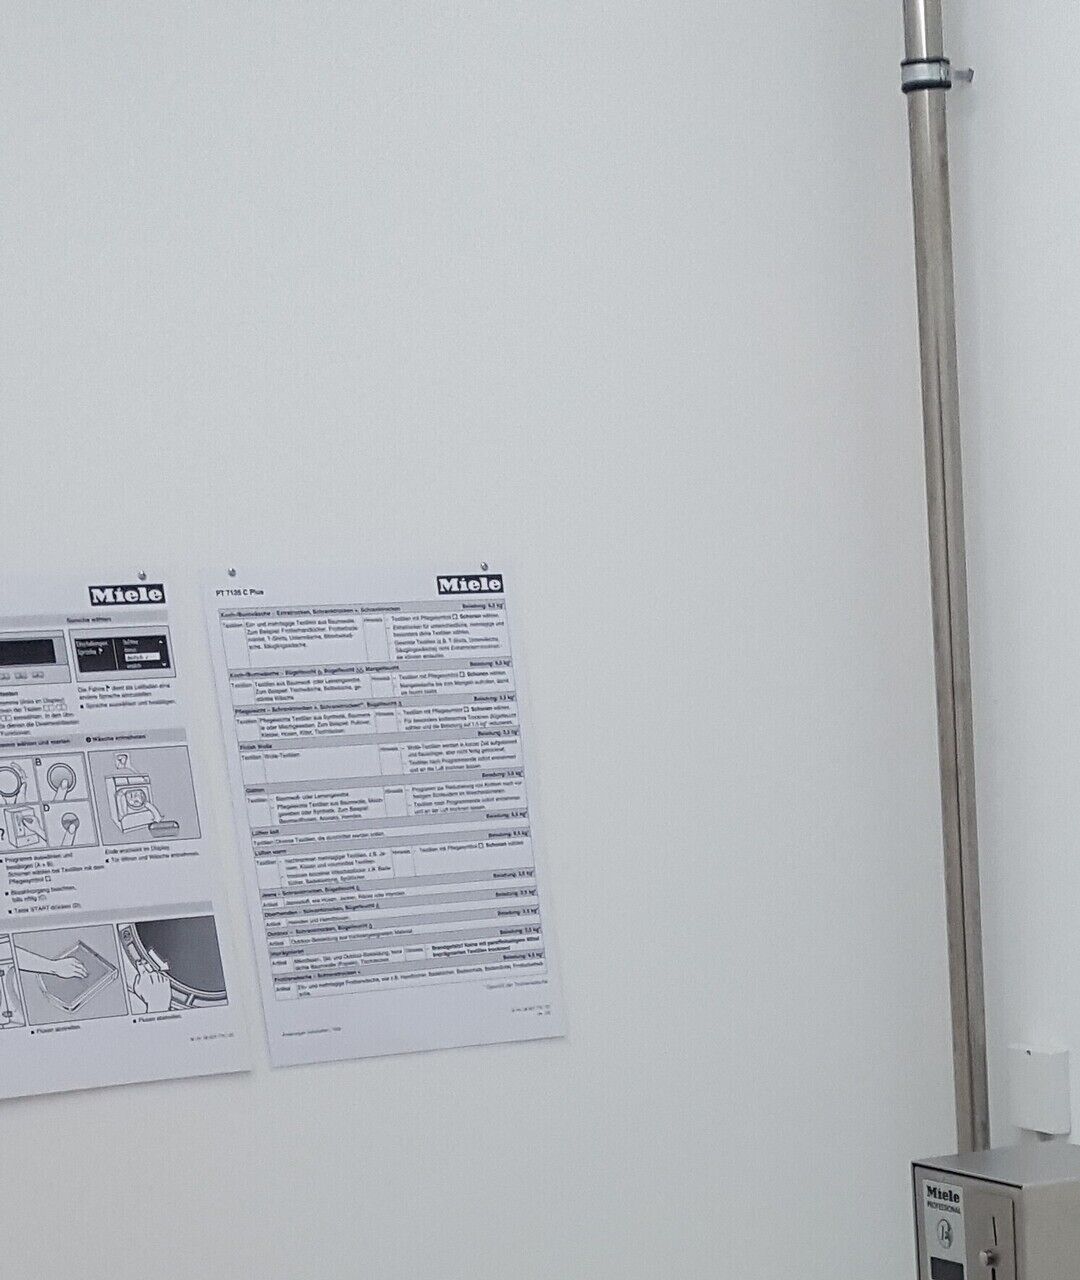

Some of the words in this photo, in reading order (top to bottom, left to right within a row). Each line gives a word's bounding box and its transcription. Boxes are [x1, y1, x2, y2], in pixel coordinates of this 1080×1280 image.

[439, 577, 501, 592] Miele
[90, 586, 163, 604] Miele
[250, 588, 264, 596] Plus
[35, 757, 42, 766] B
[43, 804, 50, 812] D
[926, 1185, 960, 1204] Miele
